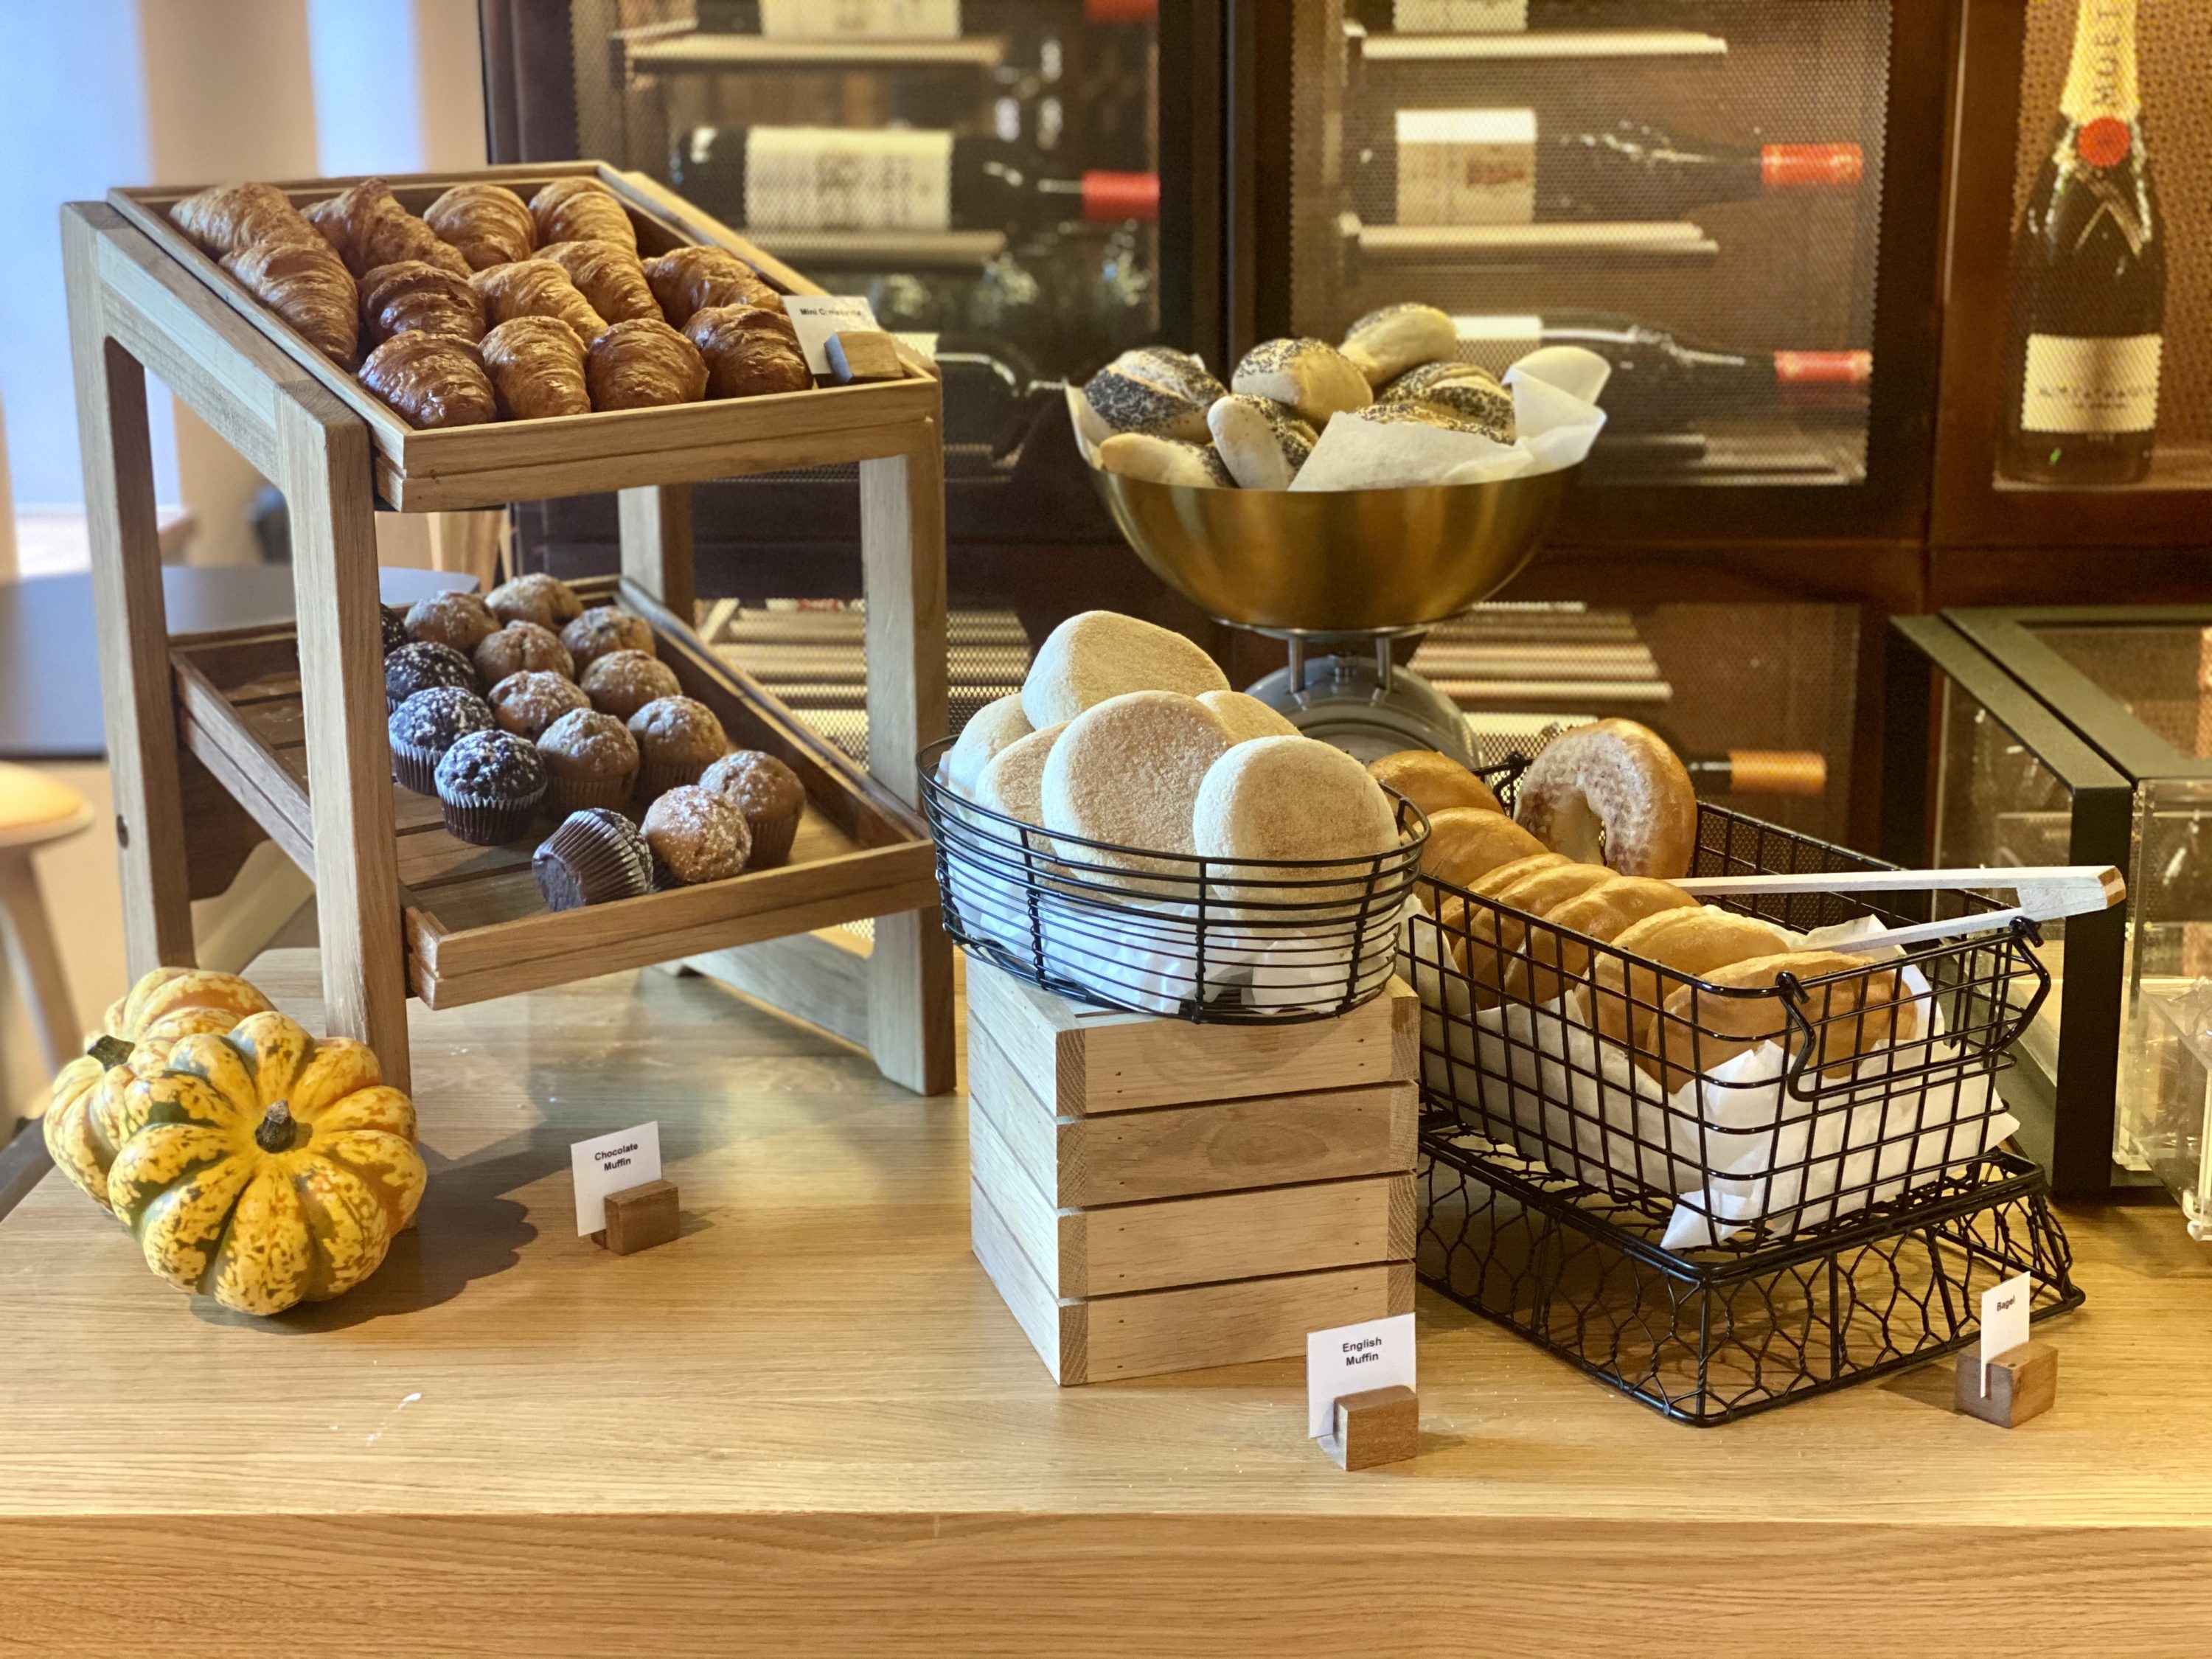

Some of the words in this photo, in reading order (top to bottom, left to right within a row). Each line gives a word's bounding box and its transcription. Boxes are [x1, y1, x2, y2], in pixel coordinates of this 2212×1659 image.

[594, 1144, 639, 1161] Chocolate
[604, 1158, 631, 1172] Muffin
[1997, 1295, 2015, 1312] Bagel
[1343, 1337, 1382, 1353] English
[1346, 1352, 1379, 1366] Muffin
